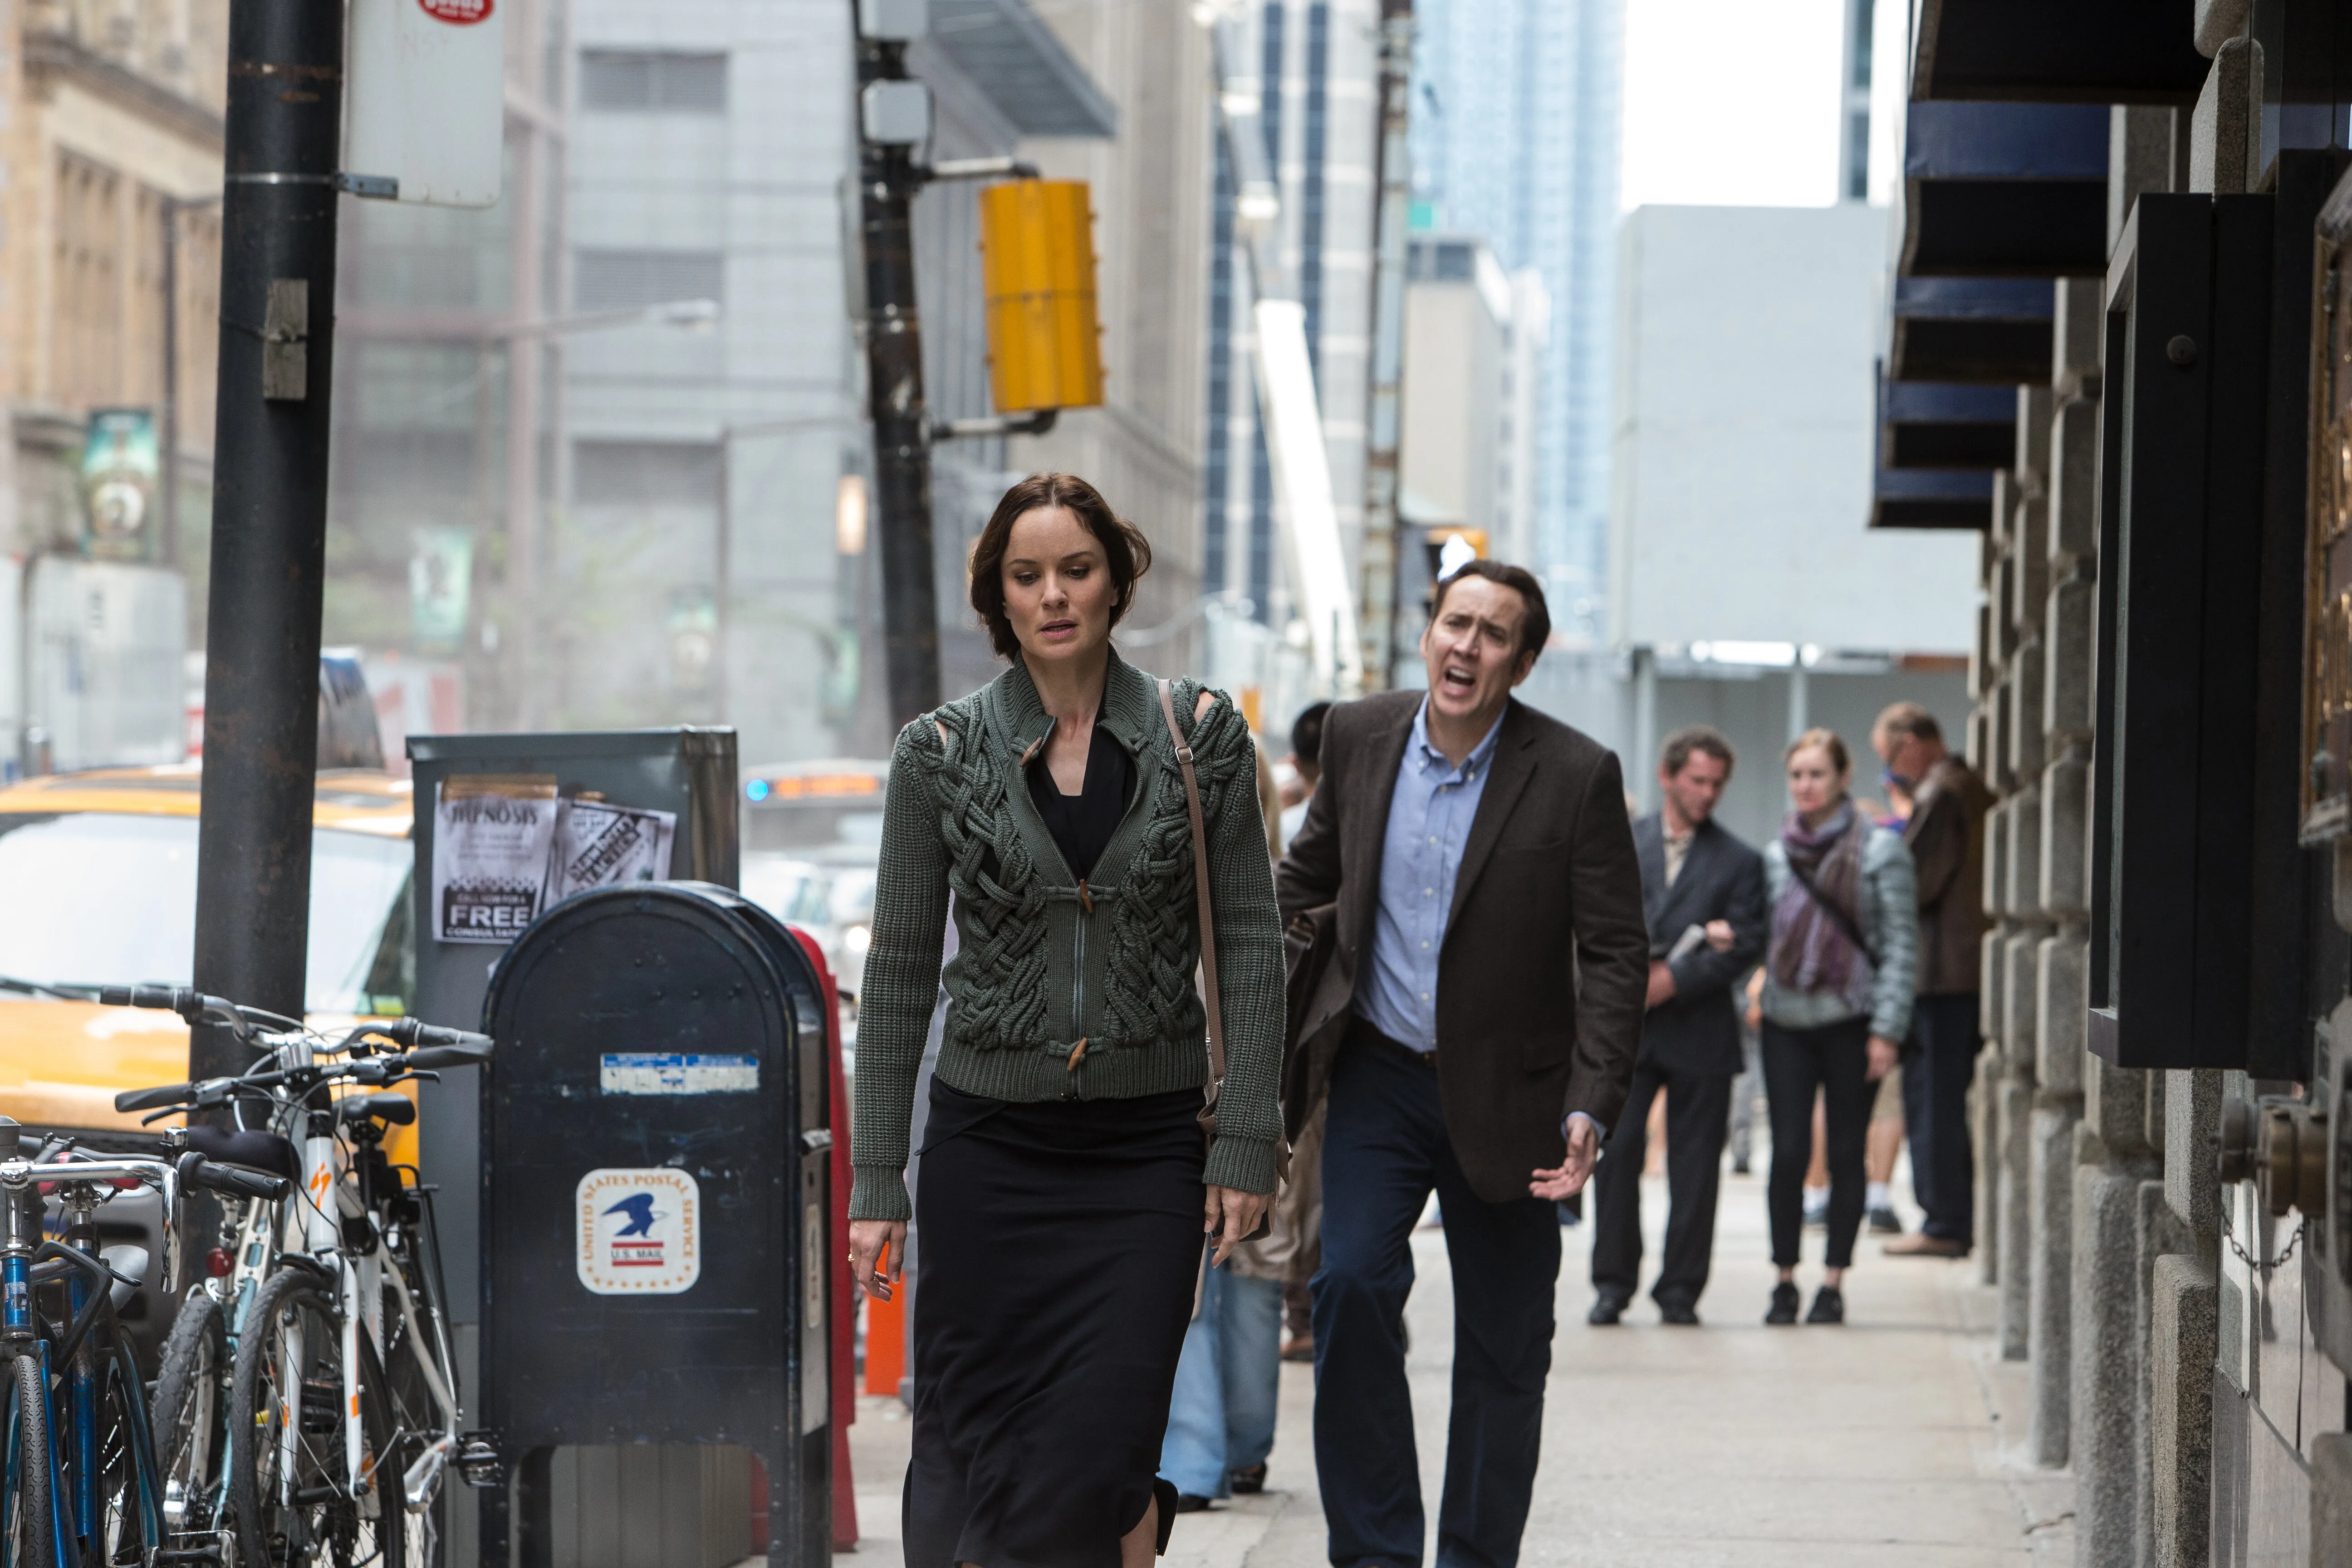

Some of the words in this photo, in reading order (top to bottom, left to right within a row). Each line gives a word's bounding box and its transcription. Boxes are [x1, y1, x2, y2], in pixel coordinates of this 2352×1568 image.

[450, 905, 530, 927] FREE
[583, 1176, 629, 1200] STATES
[634, 1175, 689, 1194] POSTAL
[583, 1205, 593, 1260] UNITED
[683, 1199, 693, 1258] SERVICE
[611, 1250, 631, 1258] U.S.
[636, 1249, 664, 1258] MAIL
